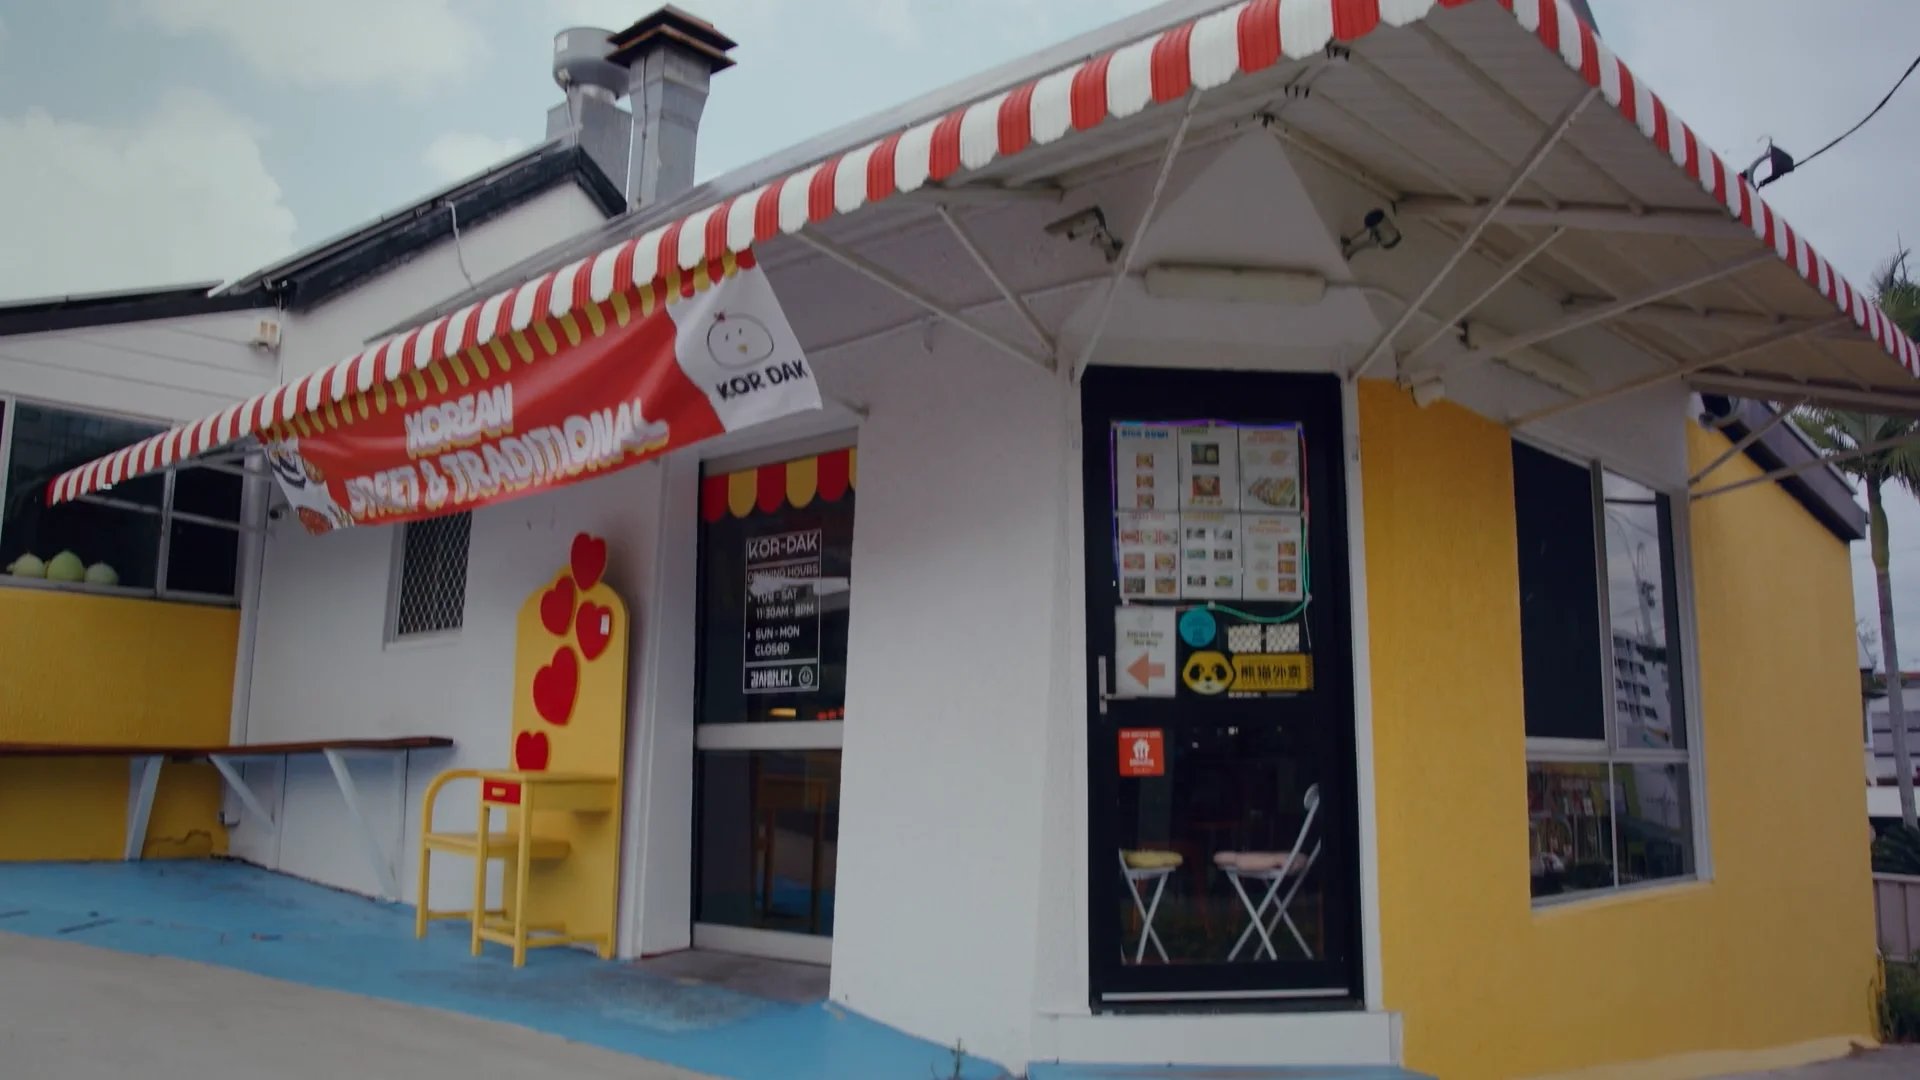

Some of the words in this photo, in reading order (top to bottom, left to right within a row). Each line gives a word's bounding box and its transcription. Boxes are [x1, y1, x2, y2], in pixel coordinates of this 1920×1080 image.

[715, 370, 766, 401] KOR
[765, 358, 808, 385] DAK
[404, 381, 513, 458] KOREAN
[344, 465, 419, 519] SREET
[420, 458, 448, 510] &
[440, 397, 669, 504] TRADITIONAL
[748, 533, 818, 559] KOR-DAK
[780, 624, 800, 639] MON
